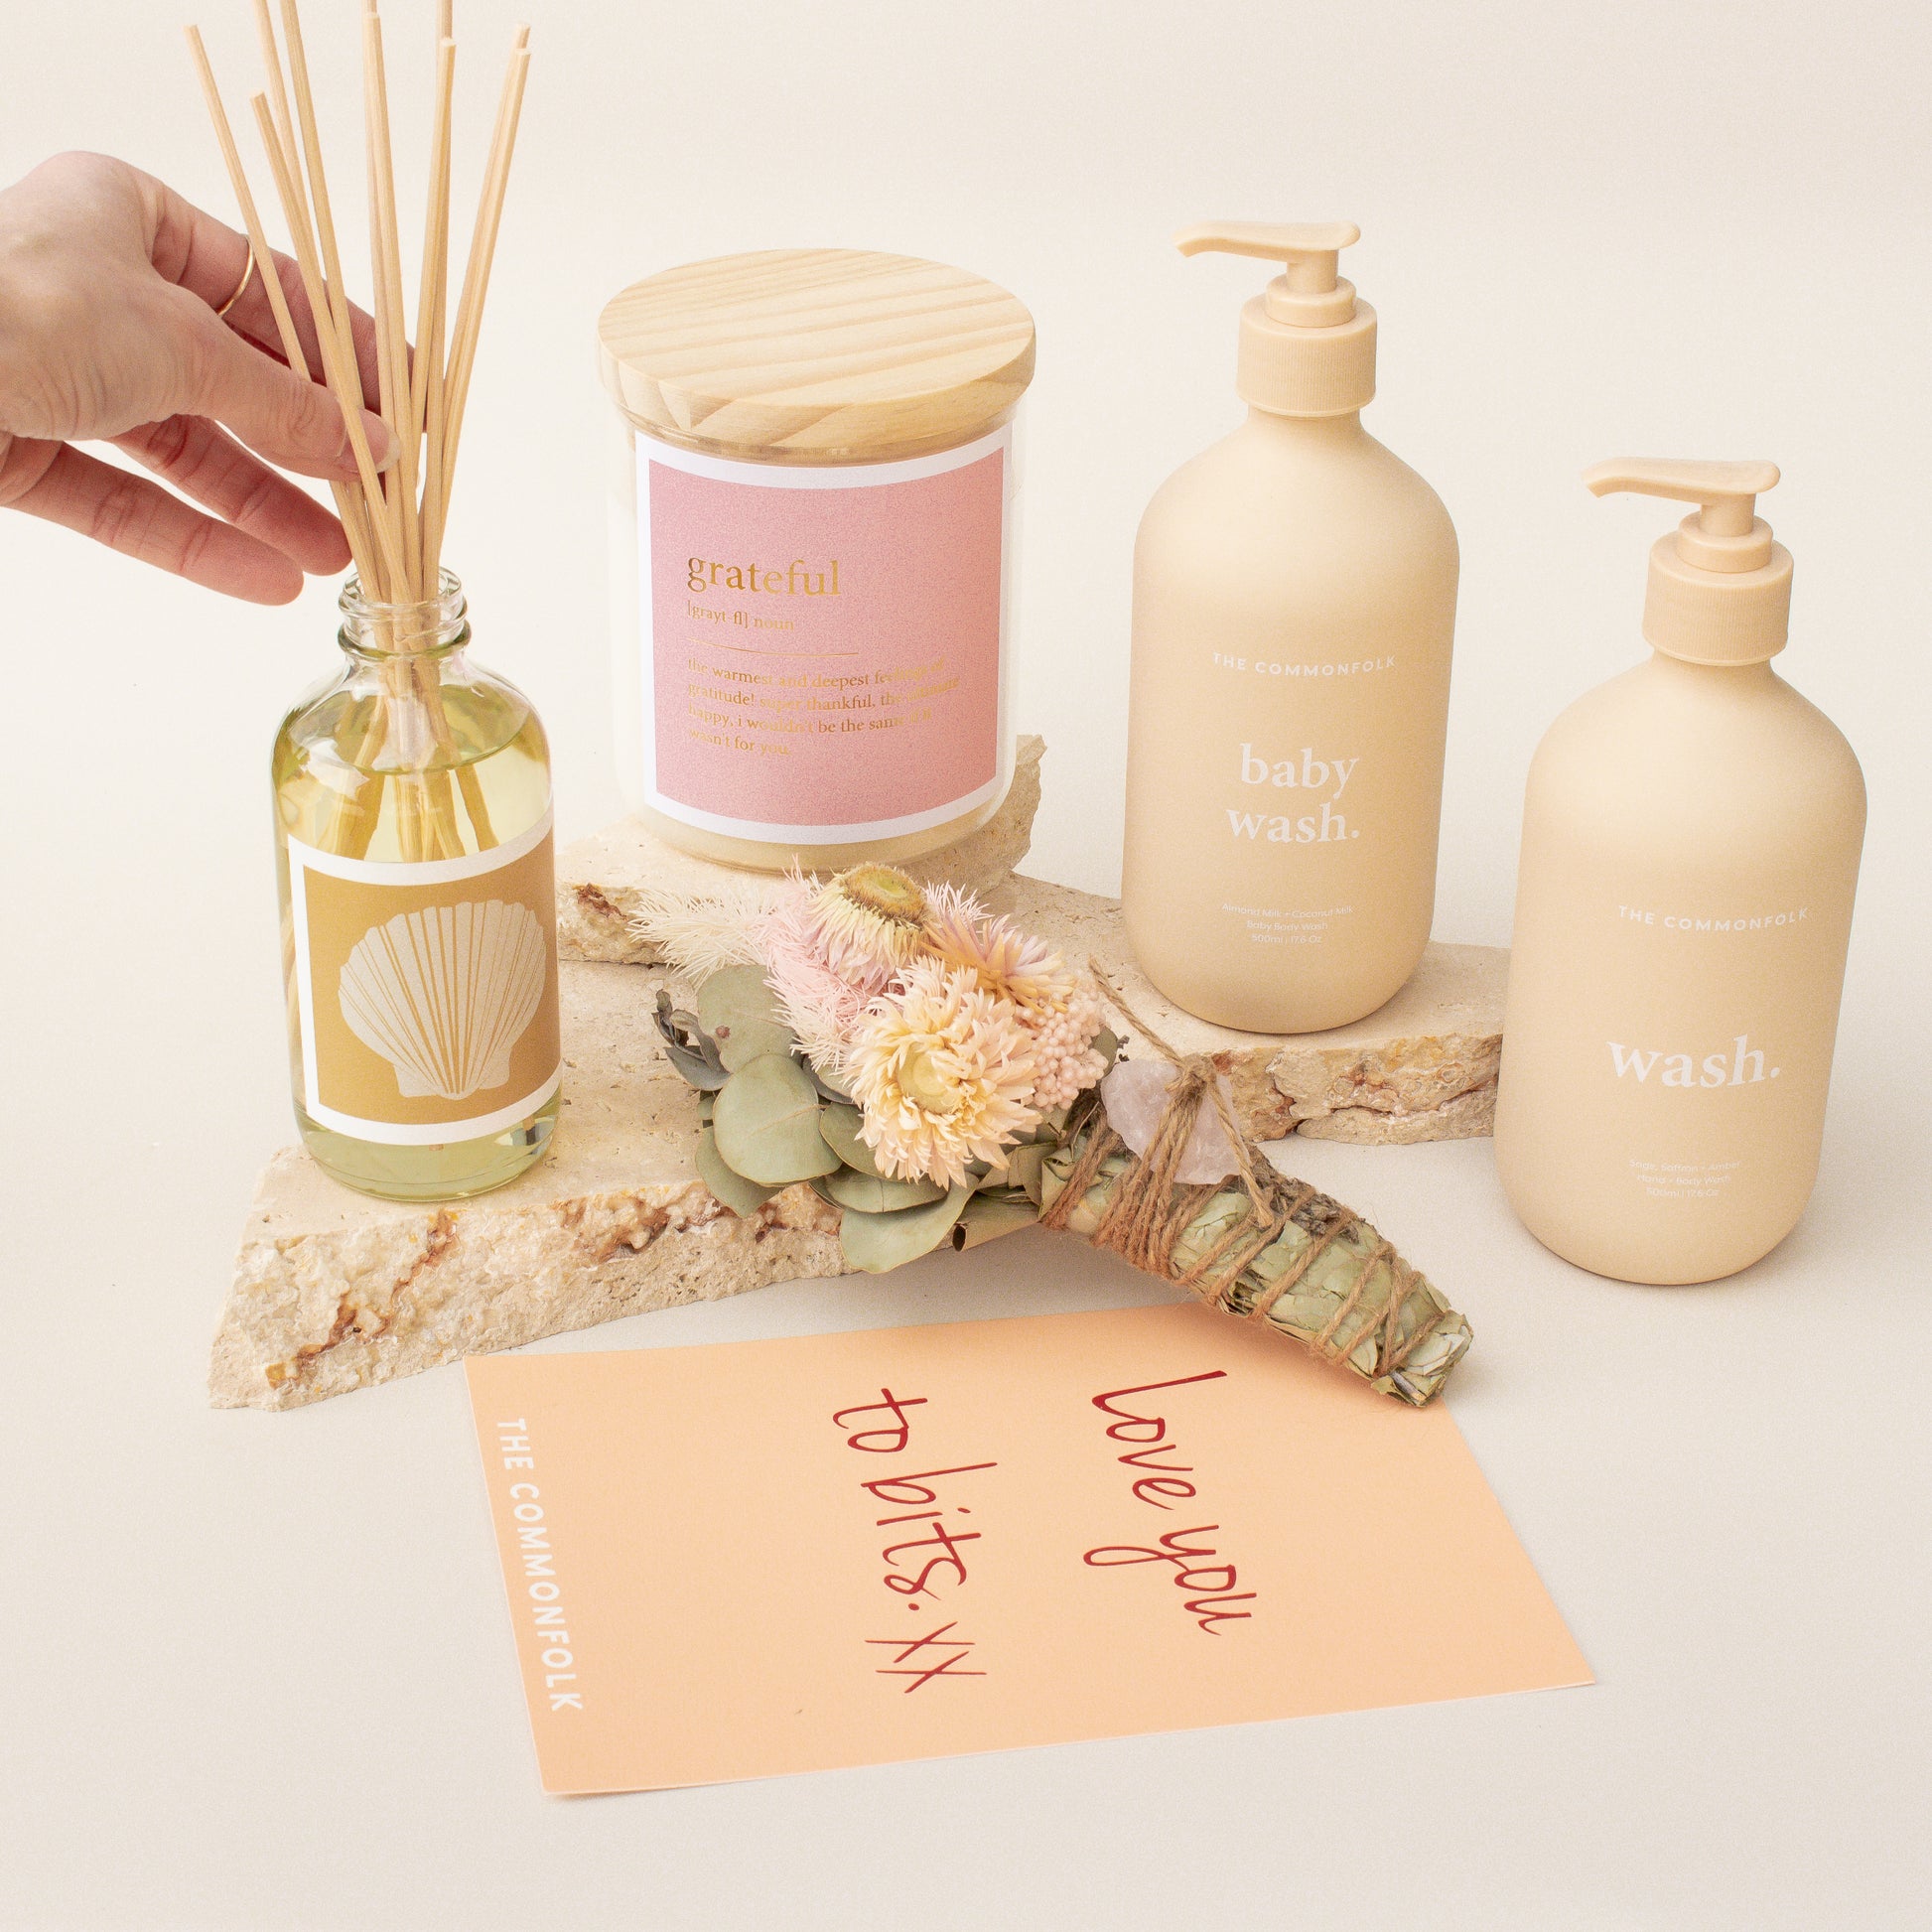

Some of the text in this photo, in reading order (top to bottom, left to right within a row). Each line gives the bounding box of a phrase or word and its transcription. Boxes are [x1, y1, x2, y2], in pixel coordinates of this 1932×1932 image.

[687, 557, 841, 597] grateful
[754, 617, 795, 630] noun
[688, 658, 708, 673] the
[712, 668, 773, 685] warmest
[778, 675, 807, 688] and
[811, 674, 869, 691] deepest
[1212, 651, 1396, 677] THE COMMONFOLK
[688, 682, 755, 706] gratitude!
[759, 697, 801, 713] super
[807, 694, 876, 712] thankful,
[880, 691, 902, 706] the
[688, 705, 734, 727] happy,
[747, 718, 814, 733] wouldn't
[818, 719, 837, 733] be
[841, 718, 864, 733] the
[869, 717, 905, 731] same
[688, 728, 791, 757] wasn't for you.
[1240, 743, 1359, 799] baby
[1225, 801, 1360, 844] wash.
[1221, 902, 1260, 916] Almond
[1262, 908, 1280, 917] Milk
[1292, 908, 1332, 918] Coconut
[1335, 904, 1352, 914] Milk
[1246, 920, 1327, 931] Baby Body Wash
[1618, 904, 1810, 932] THE COMMONFOLK
[1251, 933, 1283, 944] 500ml
[1606, 1034, 1780, 1088] wash.
[832, 1388, 928, 1452] to
[861, 1462, 998, 1610] bits.
[496, 1417, 583, 1712] THE COMMONFOLK
[1083, 1525, 1256, 1635] you
